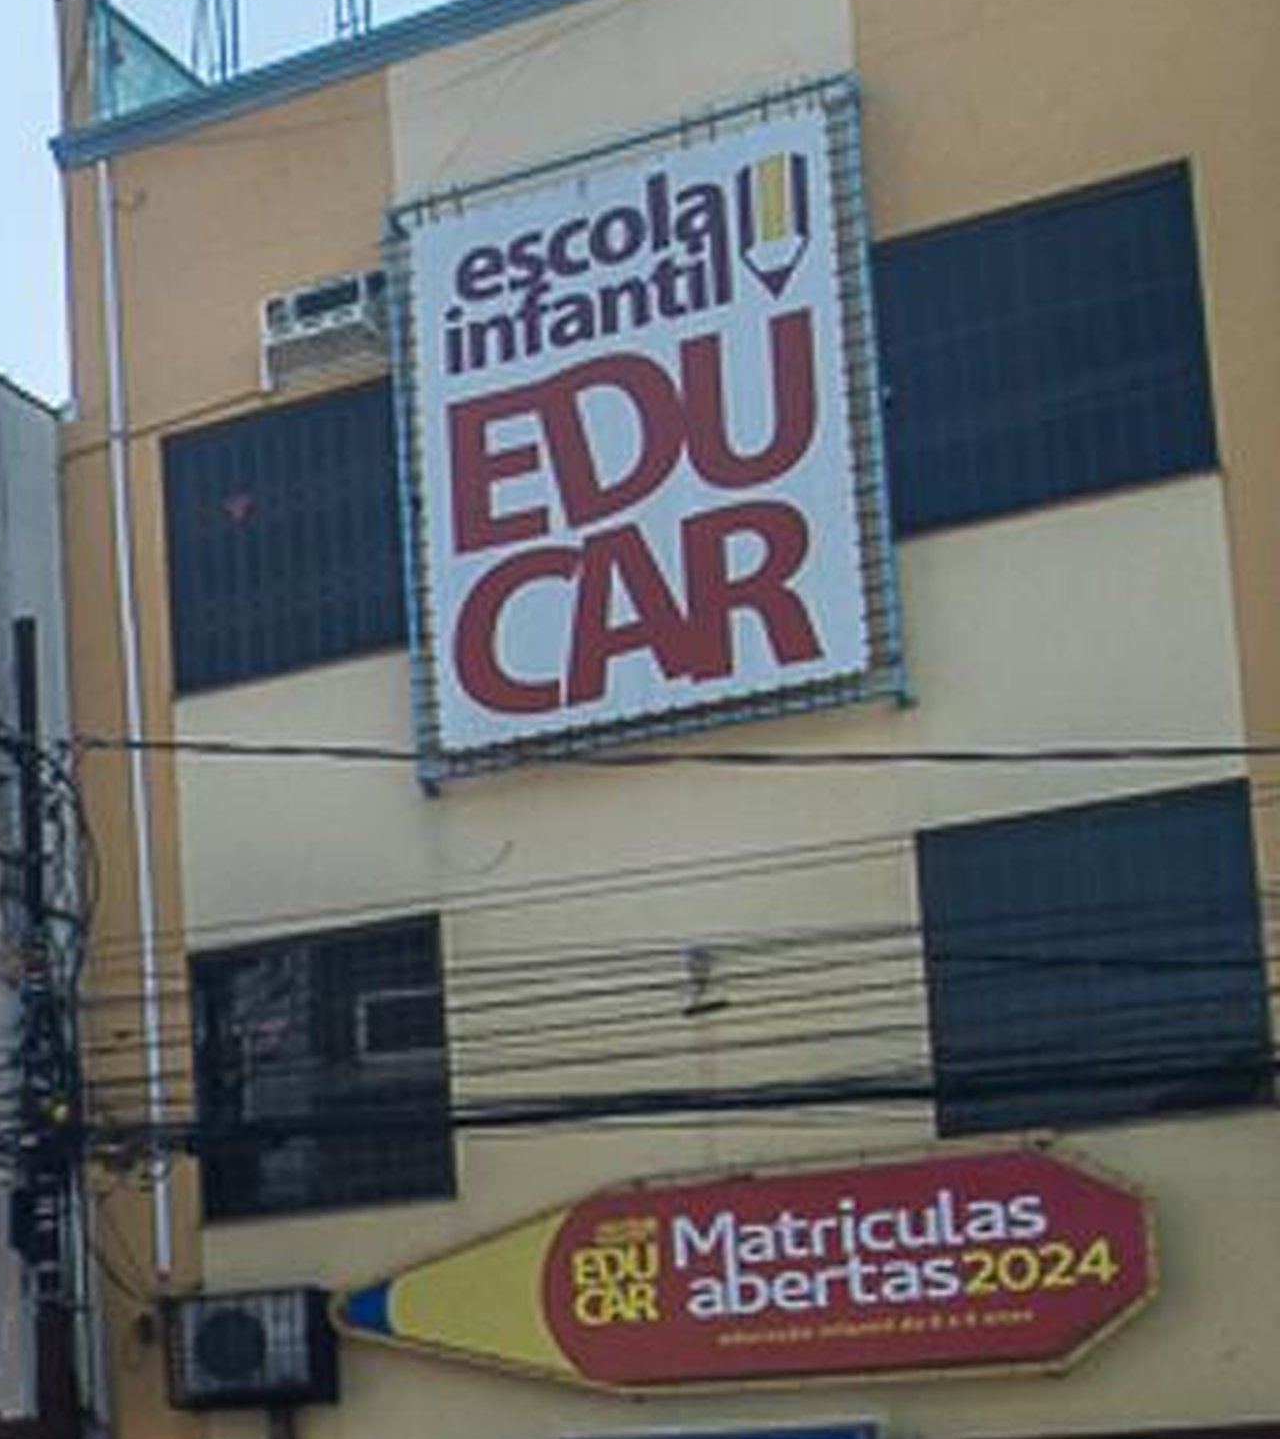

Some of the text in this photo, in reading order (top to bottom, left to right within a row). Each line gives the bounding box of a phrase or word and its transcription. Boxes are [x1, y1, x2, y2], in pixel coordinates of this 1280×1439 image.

[453, 171, 730, 303] escola
[444, 243, 733, 375] infantil
[446, 307, 816, 555] EDU
[453, 499, 825, 716] CAR
[572, 1243, 659, 1286] EDU
[574, 1283, 659, 1325] CAR
[686, 1238, 1120, 1317] abertas 2024
